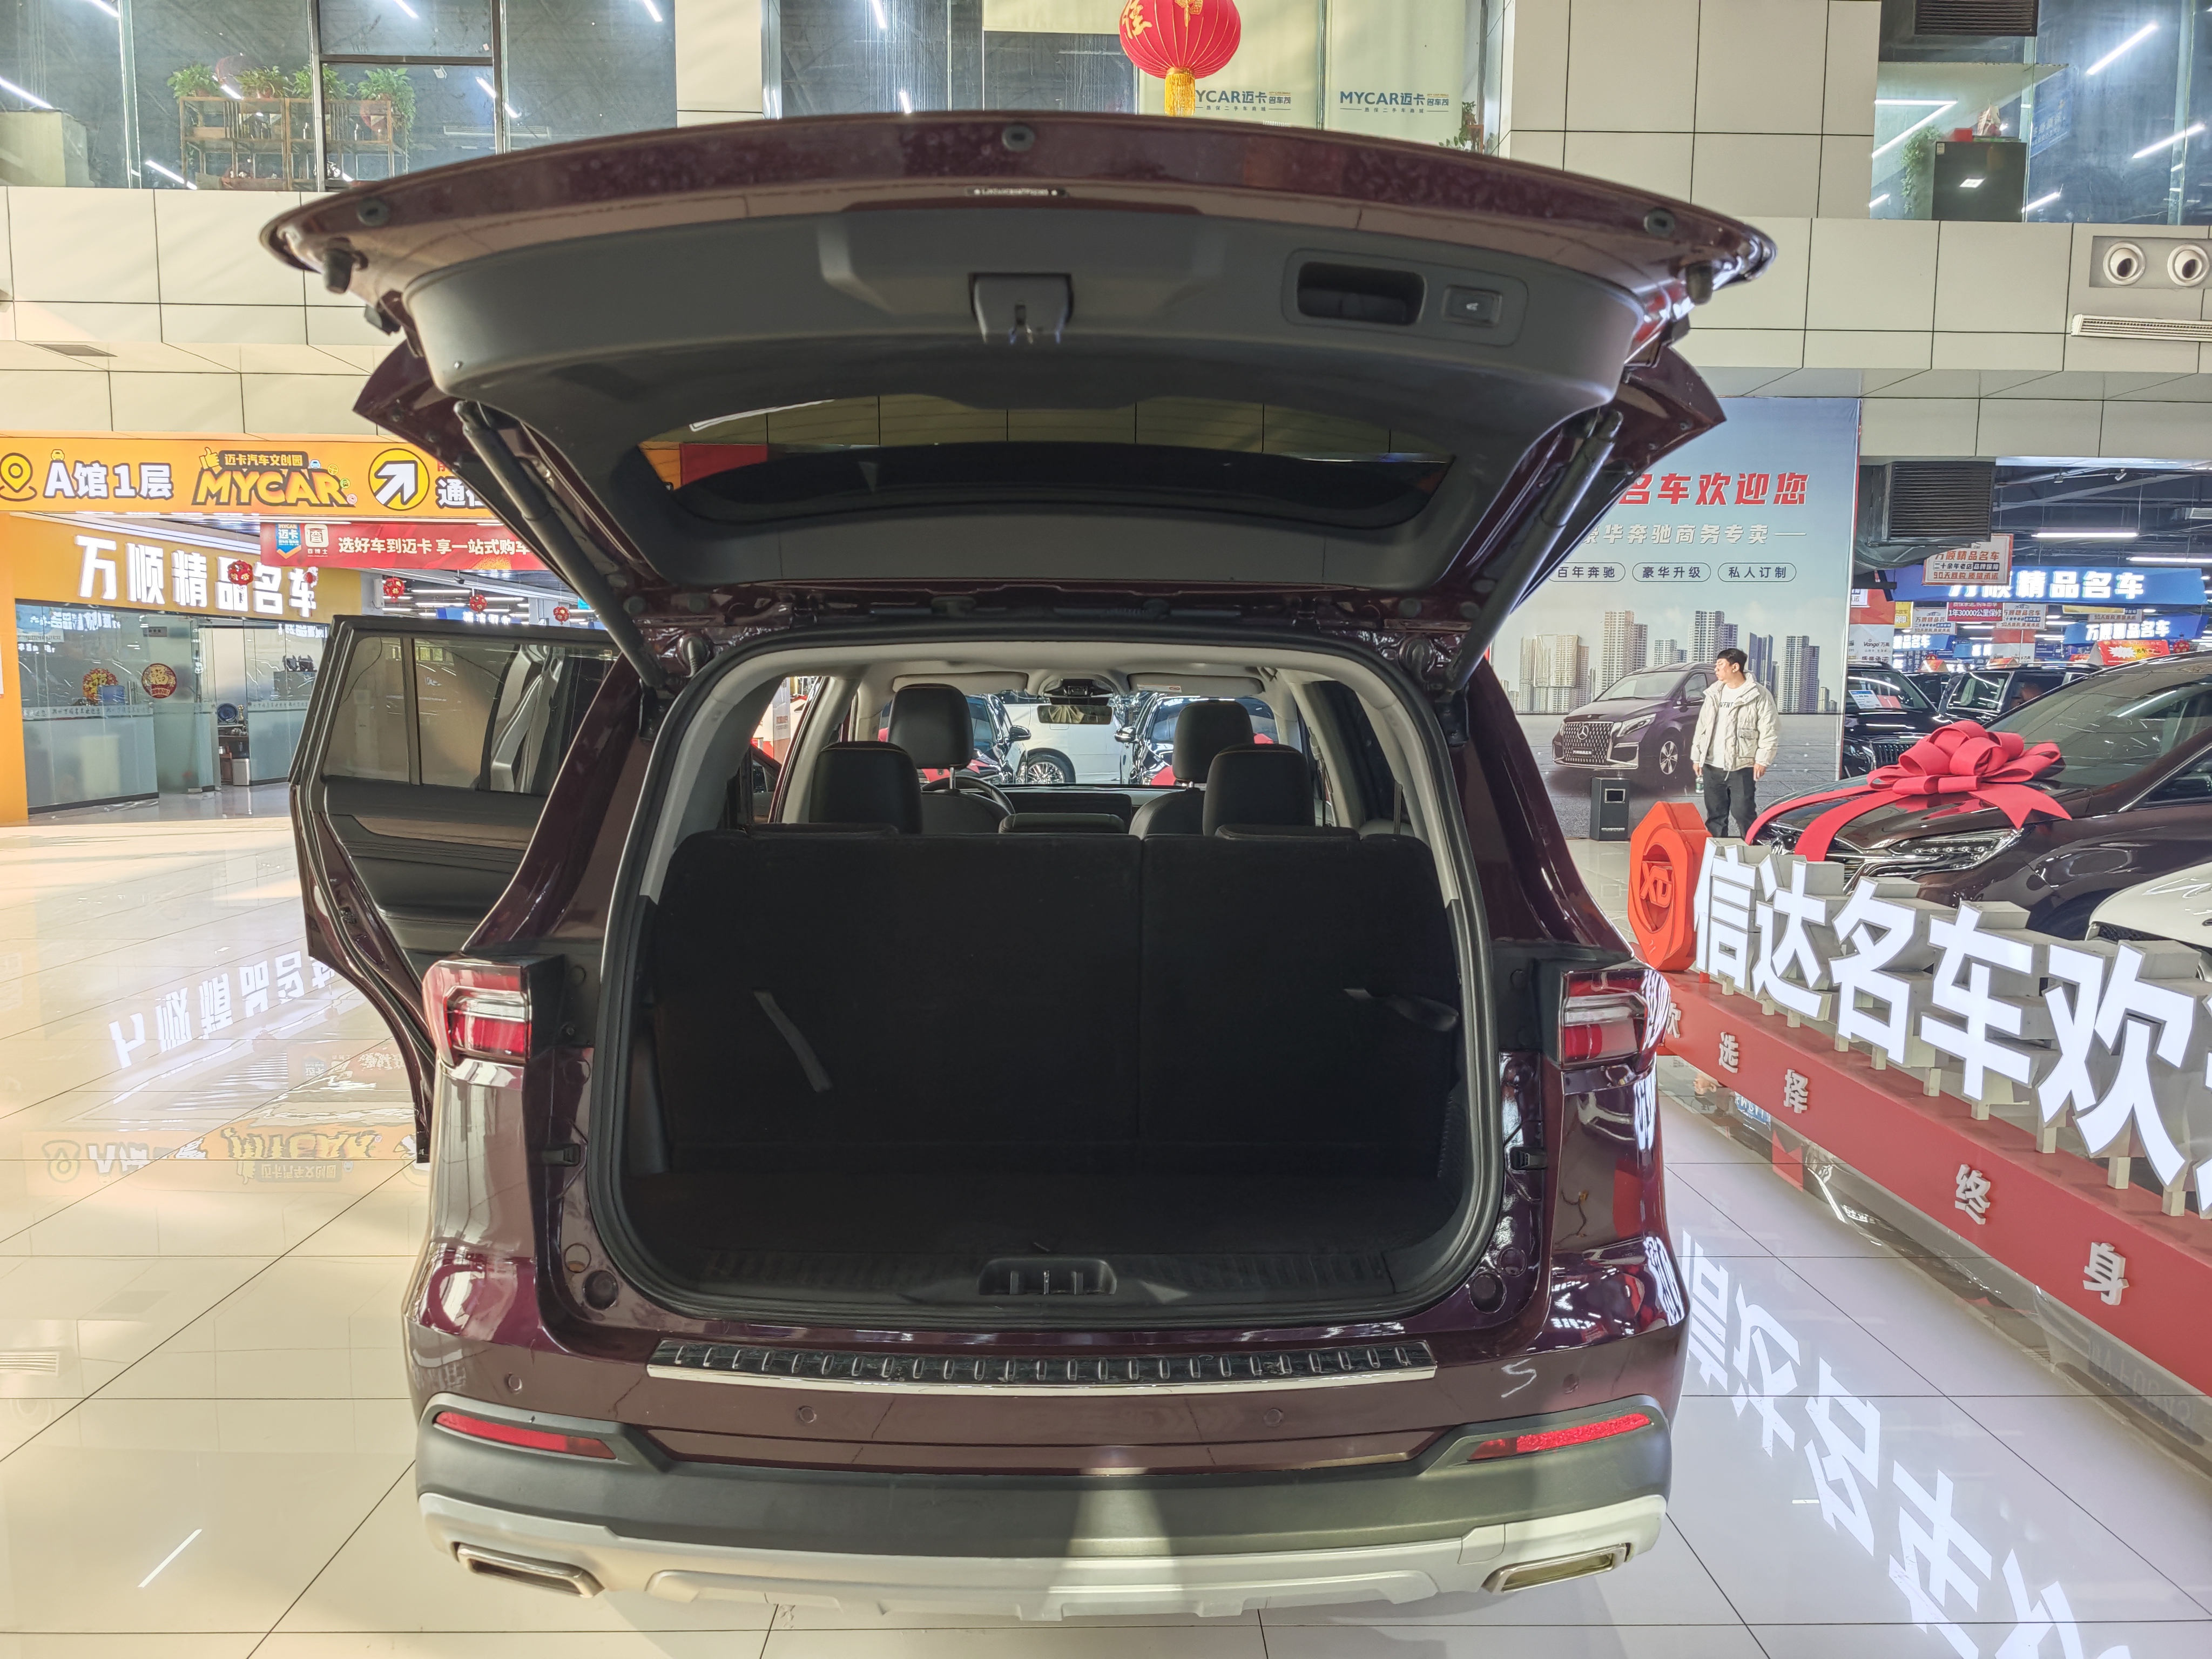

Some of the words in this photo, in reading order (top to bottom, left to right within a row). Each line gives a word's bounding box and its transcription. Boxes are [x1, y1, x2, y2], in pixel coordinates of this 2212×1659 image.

[224, 454, 304, 467] 迈卡汽车文创园
[44, 460, 174, 500] A馆1层
[192, 469, 349, 507] MYCAR
[1618, 471, 1810, 507] 名车欢迎您
[278, 529, 299, 539] 迈卡
[338, 537, 432, 554] 选好车到迈卡
[436, 538, 532, 555] 享一站式购车
[1935, 550, 2000, 561] 万顺精品名车
[75, 535, 317, 617] 万顺精品名车
[1556, 567, 1616, 578] 百年奔驰
[1642, 567, 1702, 579] 豪华升级
[1728, 567, 1787, 579] 私人订制
[1933, 571, 1966, 579] 90天回购
[1948, 609, 2002, 617] 1年30000公里保修
[1694, 837, 2212, 1212] 信达名车欢
